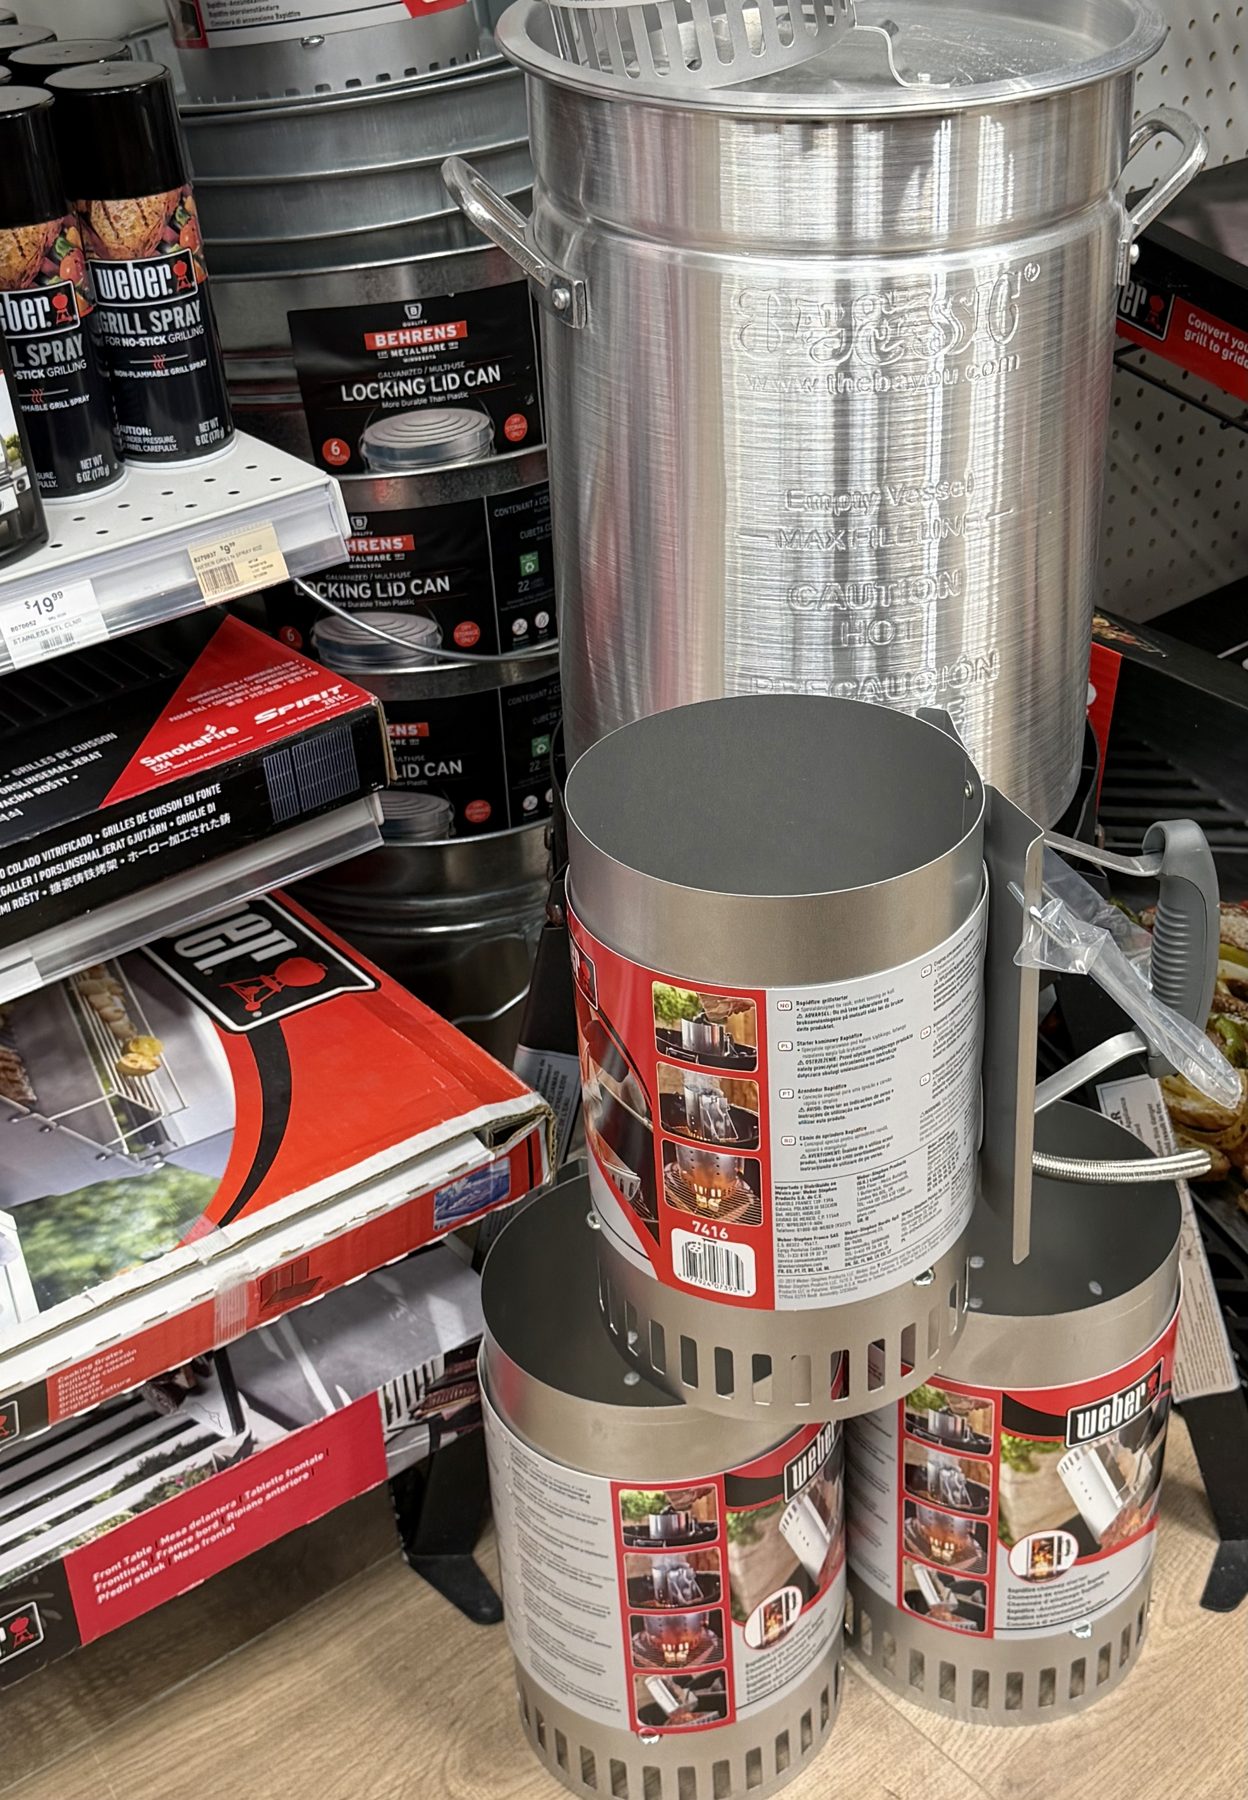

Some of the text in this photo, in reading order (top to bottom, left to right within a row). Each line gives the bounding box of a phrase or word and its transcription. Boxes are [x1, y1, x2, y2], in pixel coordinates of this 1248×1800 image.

[98, 300, 202, 335] GRILL SPRAY
[1187, 312, 1230, 344] Convert
[105, 324, 205, 347] FOR NO-STICK GRILLING
[375, 324, 458, 347] BEHRENS
[1184, 328, 1207, 348] grill
[1208, 340, 1220, 354] to
[26, 333, 84, 367] SPRAY
[390, 342, 447, 357] METALWARE
[47, 359, 87, 378] GRILLING
[114, 359, 207, 378] NON-FLAMMABLE GRILL SPRAY
[378, 361, 465, 379] GALVANIZED MULTI-USE
[340, 365, 501, 401] LOCKING LID CAN
[50, 401, 70, 411] GRILL
[70, 394, 90, 406] SPRAY
[382, 391, 469, 409] More Durable Than Plastic
[199, 417, 219, 433] NET WT
[195, 435, 201, 446] 6
[201, 433, 209, 444] OZ
[331, 441, 340, 456] 6
[80, 454, 103, 470] NET WT
[76, 473, 82, 483] 6
[82, 472, 92, 483] OZ
[784, 467, 976, 516] Empty Vessel
[775, 512, 982, 551] MAX FILL LINE
[346, 538, 404, 551] HRENS
[350, 553, 392, 563] TALWARE
[294, 575, 450, 599] LOCKING LID CAN
[326, 571, 412, 582] GALVANIZED MULTI-USE
[518, 579, 530, 593] 22
[788, 569, 963, 611] CAUTION
[348, 600, 374, 608] Durable
[13, 629, 49, 646] STAINLESS
[287, 629, 295, 641] 6
[840, 619, 917, 648] HOT
[254, 684, 343, 725] SPIRIT
[11, 732, 118, 776] GRILLES DE CUISSON
[139, 724, 240, 768] SmokeFire
[0, 750, 103, 795] ORSLINSEMALJERAT
[424, 759, 463, 777] CAN
[32, 777, 70, 795] ROŠTY
[406, 779, 428, 787] Plastic
[6, 854, 41, 876] COLADO
[41, 834, 93, 862] VITRIFICADO
[101, 817, 136, 839] GRILLES
[136, 812, 149, 825] DE
[148, 799, 183, 820] CUISSON
[183, 793, 195, 806] EN
[195, 783, 222, 802] FONTE
[38, 837, 127, 881] PORSLINSEMALJERAT
[126, 821, 168, 846] GJUTJÄRN
[175, 805, 207, 826] GRIGLIE
[207, 801, 217, 813] DI
[11, 889, 40, 910] ROŠTY
[691, 1220, 729, 1240] 7416
[58, 1349, 123, 1384] Cooking Grates
[92, 1451, 325, 1583] Front Table Mesa delantera Tablette frontale
[94, 1470, 310, 1593] Fronttisch Främre bord Ripiano anteriore
[133, 1561, 167, 1584] stolek
[172, 1545, 201, 1564] Mesa
[200, 1522, 236, 1548] frontal
